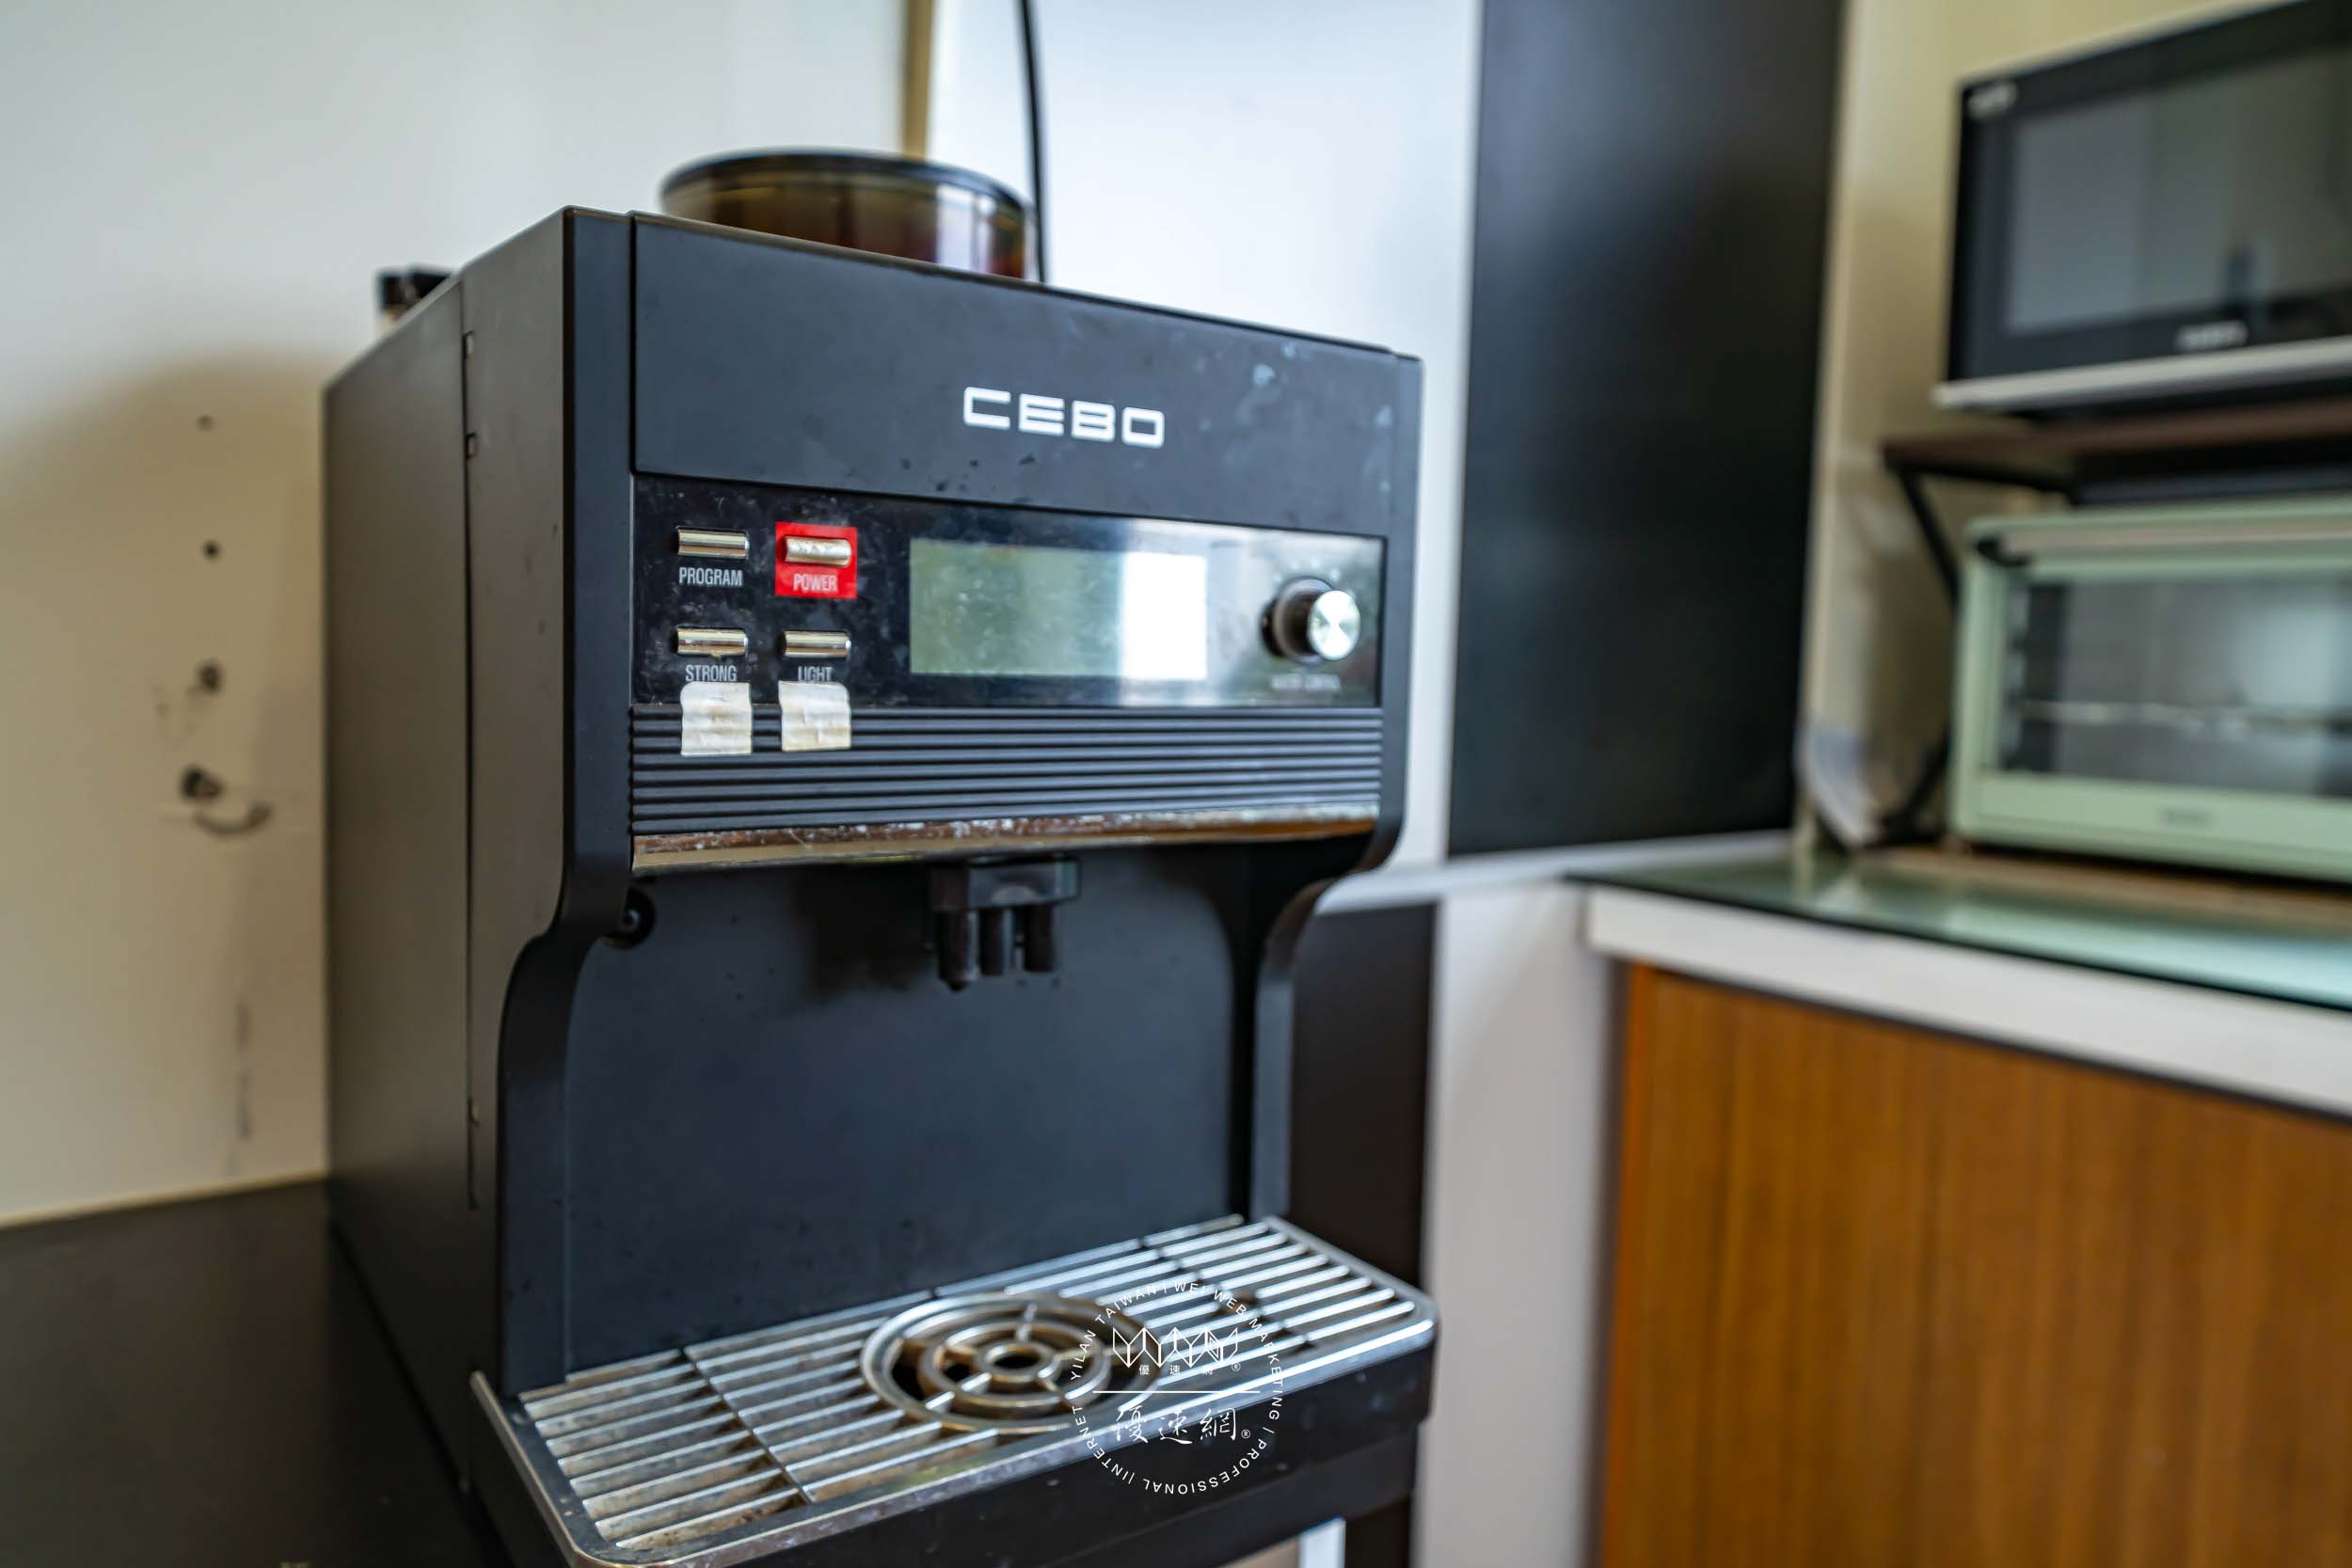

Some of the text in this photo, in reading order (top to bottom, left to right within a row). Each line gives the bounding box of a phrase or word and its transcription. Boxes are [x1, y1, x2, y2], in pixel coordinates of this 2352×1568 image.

[962, 386, 1166, 449] CEBO
[679, 566, 743, 586] PROGRAM
[793, 573, 839, 593] POWER
[685, 664, 738, 682] STRONG
[798, 666, 834, 682] LIGHT
